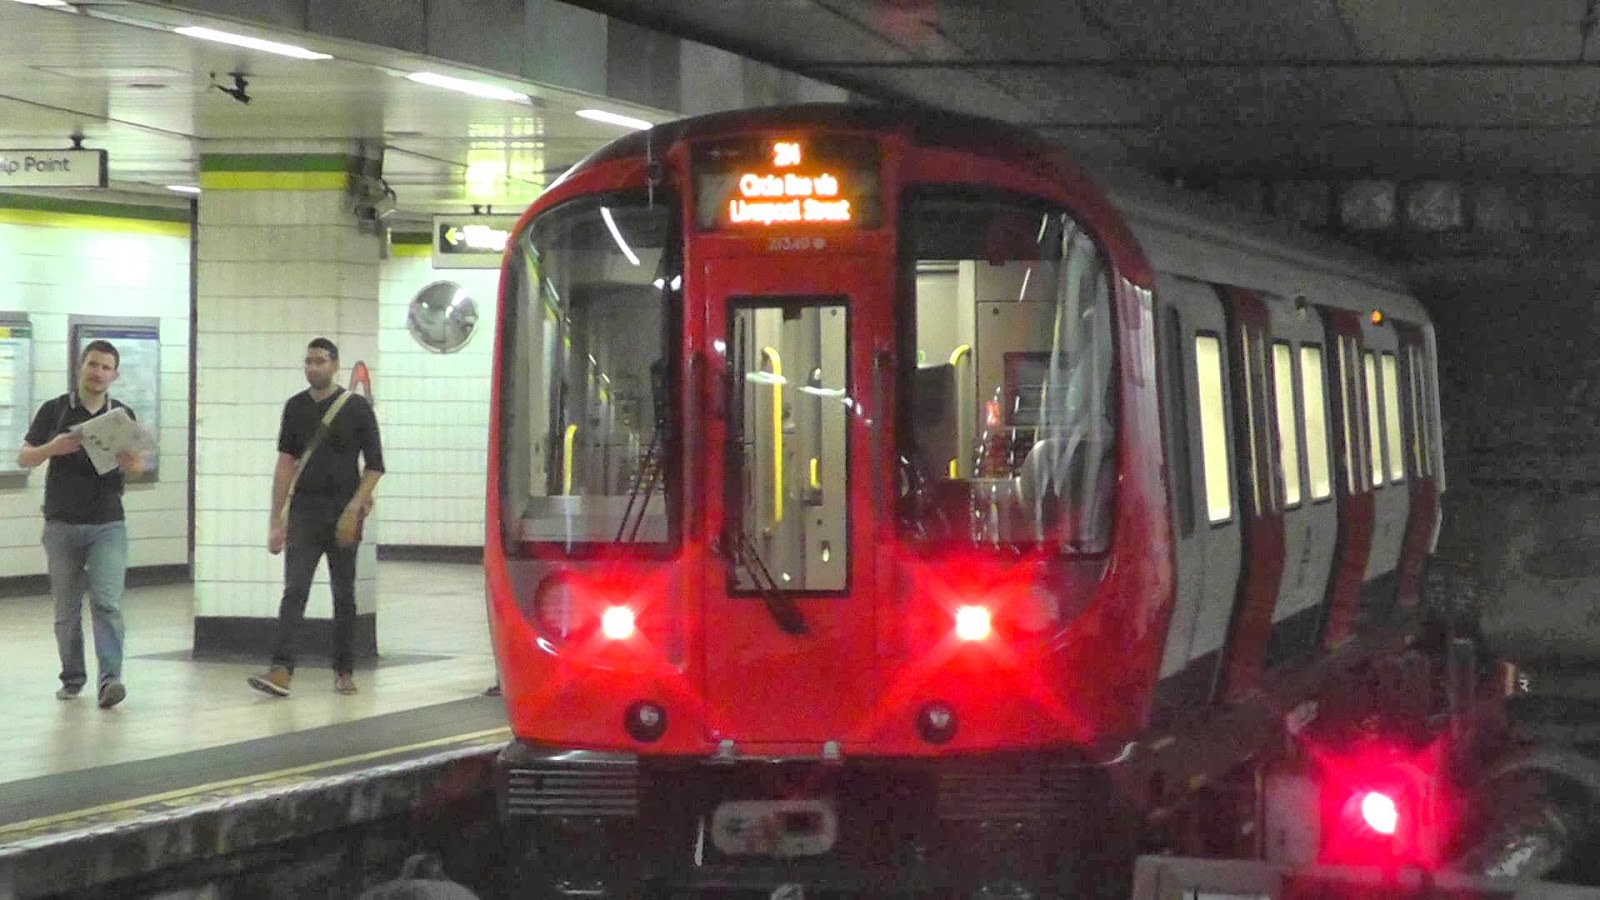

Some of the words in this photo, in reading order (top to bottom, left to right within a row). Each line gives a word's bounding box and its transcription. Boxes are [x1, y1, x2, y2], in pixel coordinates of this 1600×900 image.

[25, 156, 70, 172] Point
[740, 174, 784, 196] Circle
[814, 173, 838, 196] via
[730, 200, 801, 225] Liverpool
[804, 199, 850, 220] Street
